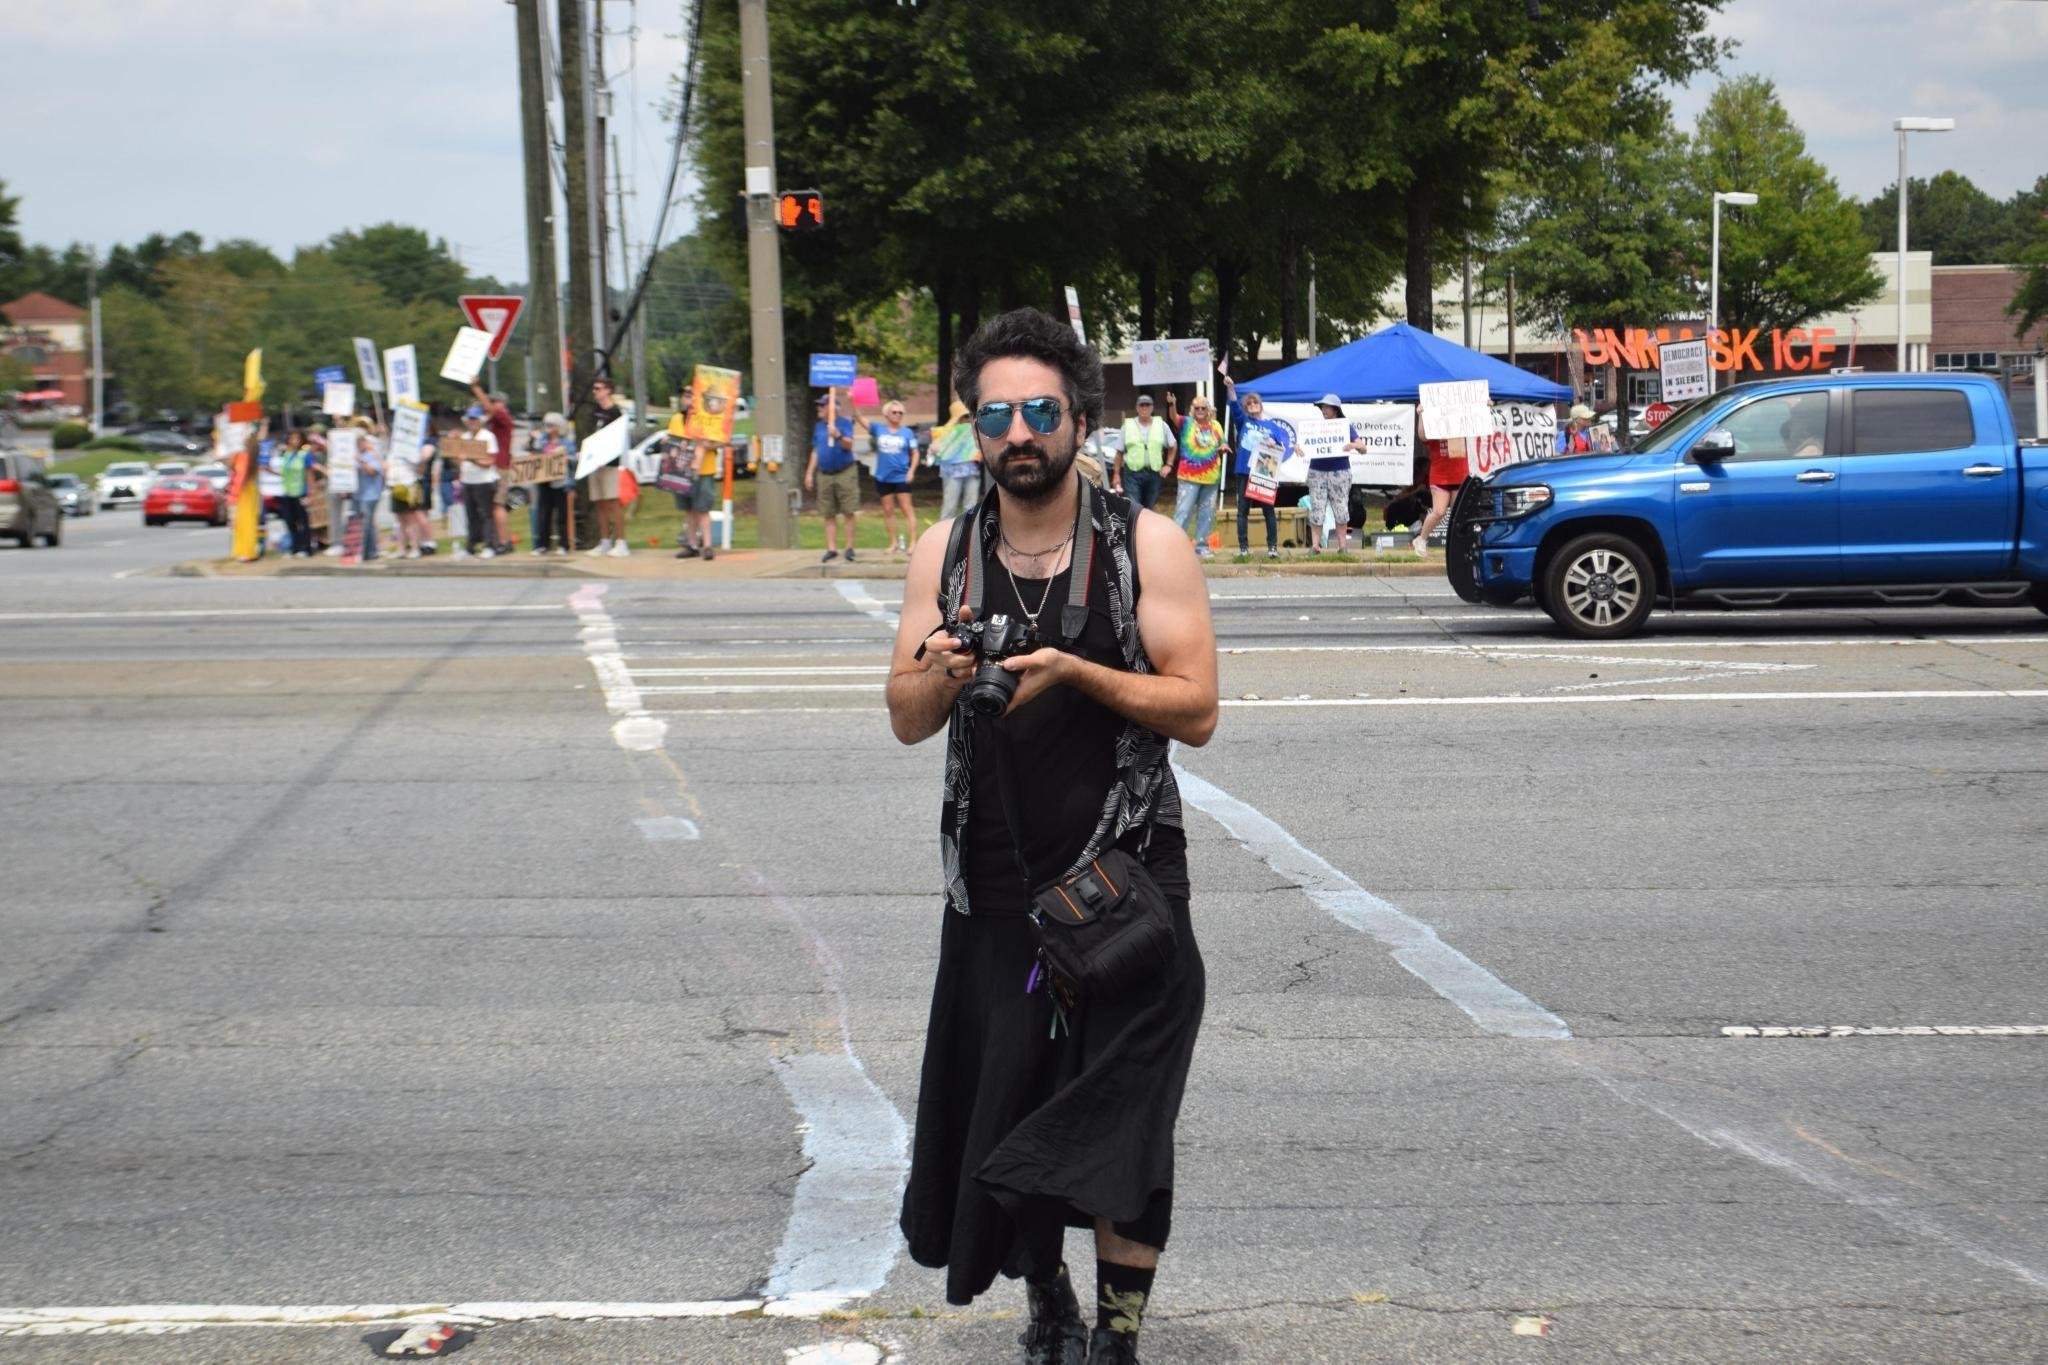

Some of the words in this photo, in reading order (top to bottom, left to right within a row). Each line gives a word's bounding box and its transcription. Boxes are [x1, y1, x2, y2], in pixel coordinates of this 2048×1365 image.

[1663, 347, 1703, 361] DEMOCRACY
[1771, 328, 1837, 371] ICE
[1665, 378, 1673, 387] IN
[1675, 374, 1705, 386] SILENCE
[1364, 423, 1404, 431] Protests.
[1304, 435, 1345, 446] ABOLISH
[1359, 434, 1408, 447] ment.
[1316, 446, 1333, 455] ICE
[512, 459, 542, 484] STOP
